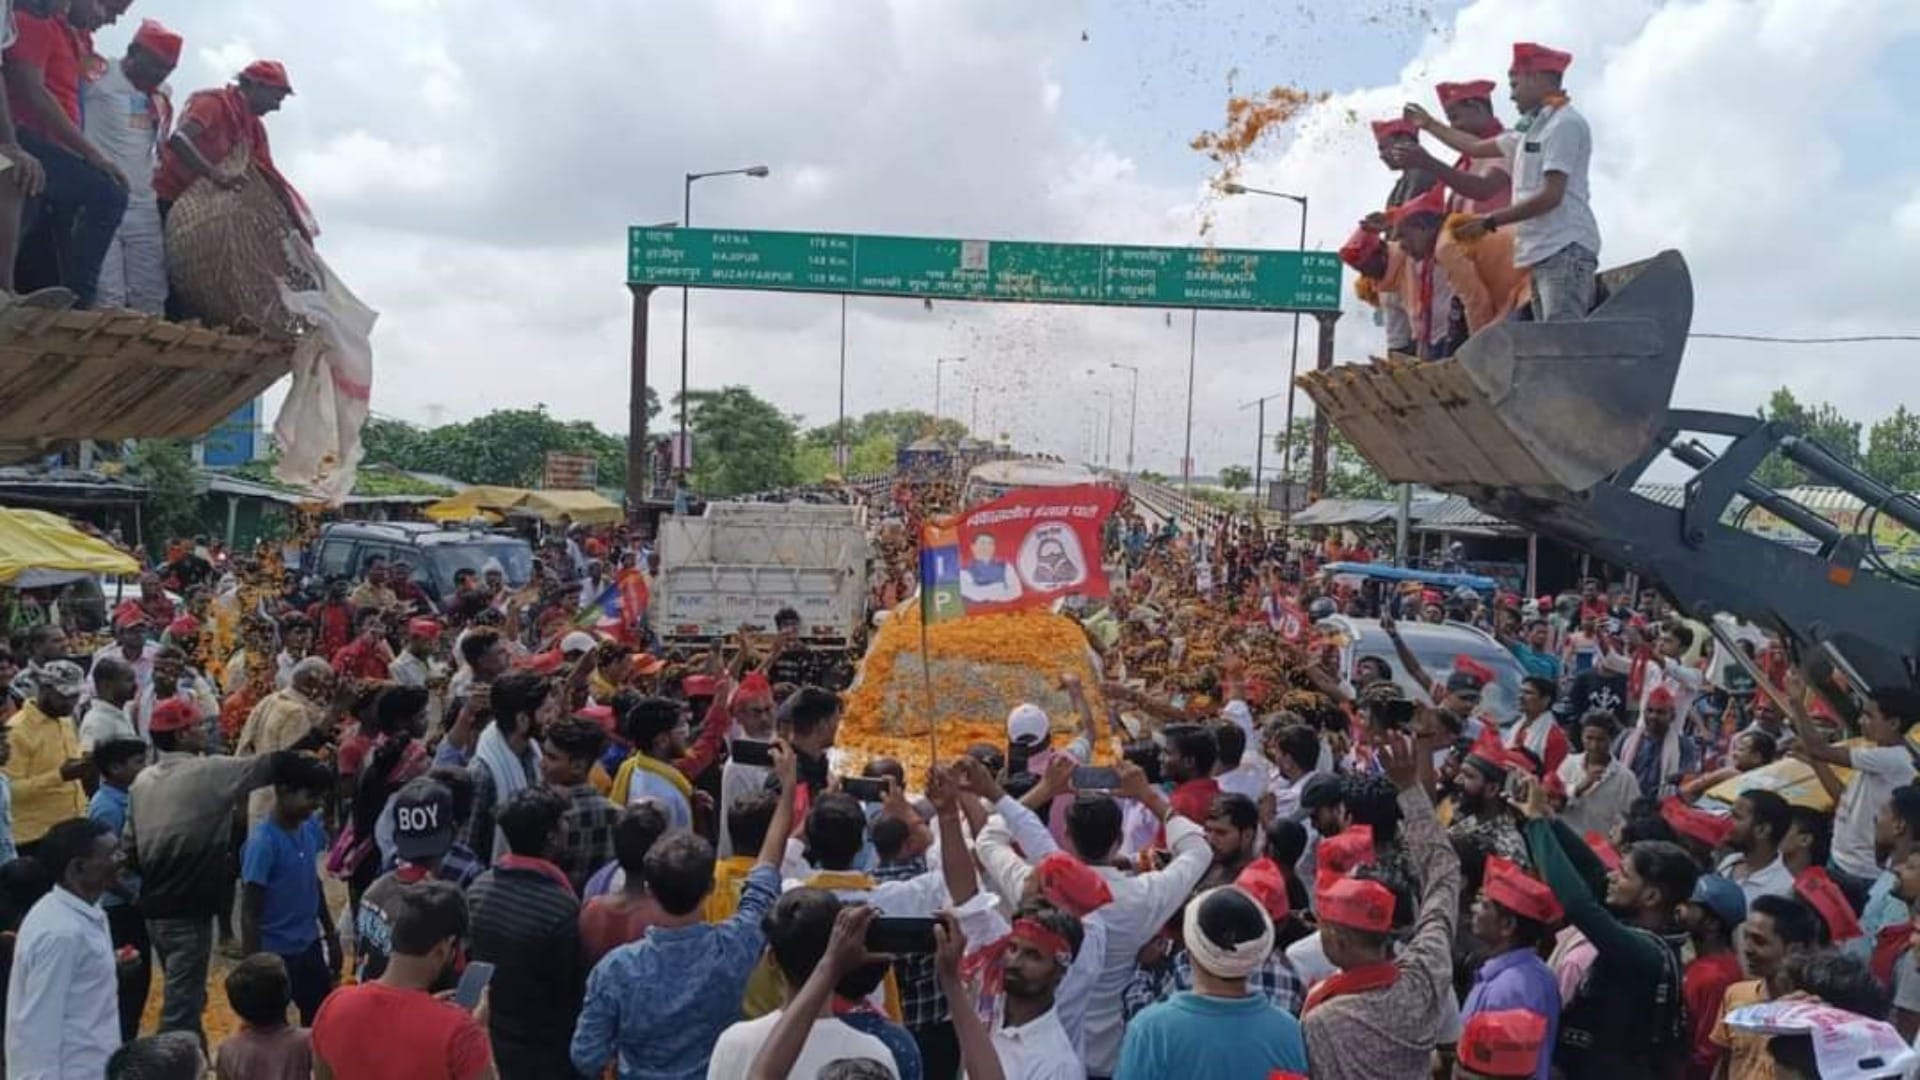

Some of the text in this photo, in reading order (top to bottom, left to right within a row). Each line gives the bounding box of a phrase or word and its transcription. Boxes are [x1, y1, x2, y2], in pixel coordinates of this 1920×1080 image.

[712, 233, 750, 245] PATNA
[712, 269, 794, 282] MUZAFFARPUR
[1184, 288, 1253, 300] MADHUBANI
[398, 804, 438, 830] BOY
